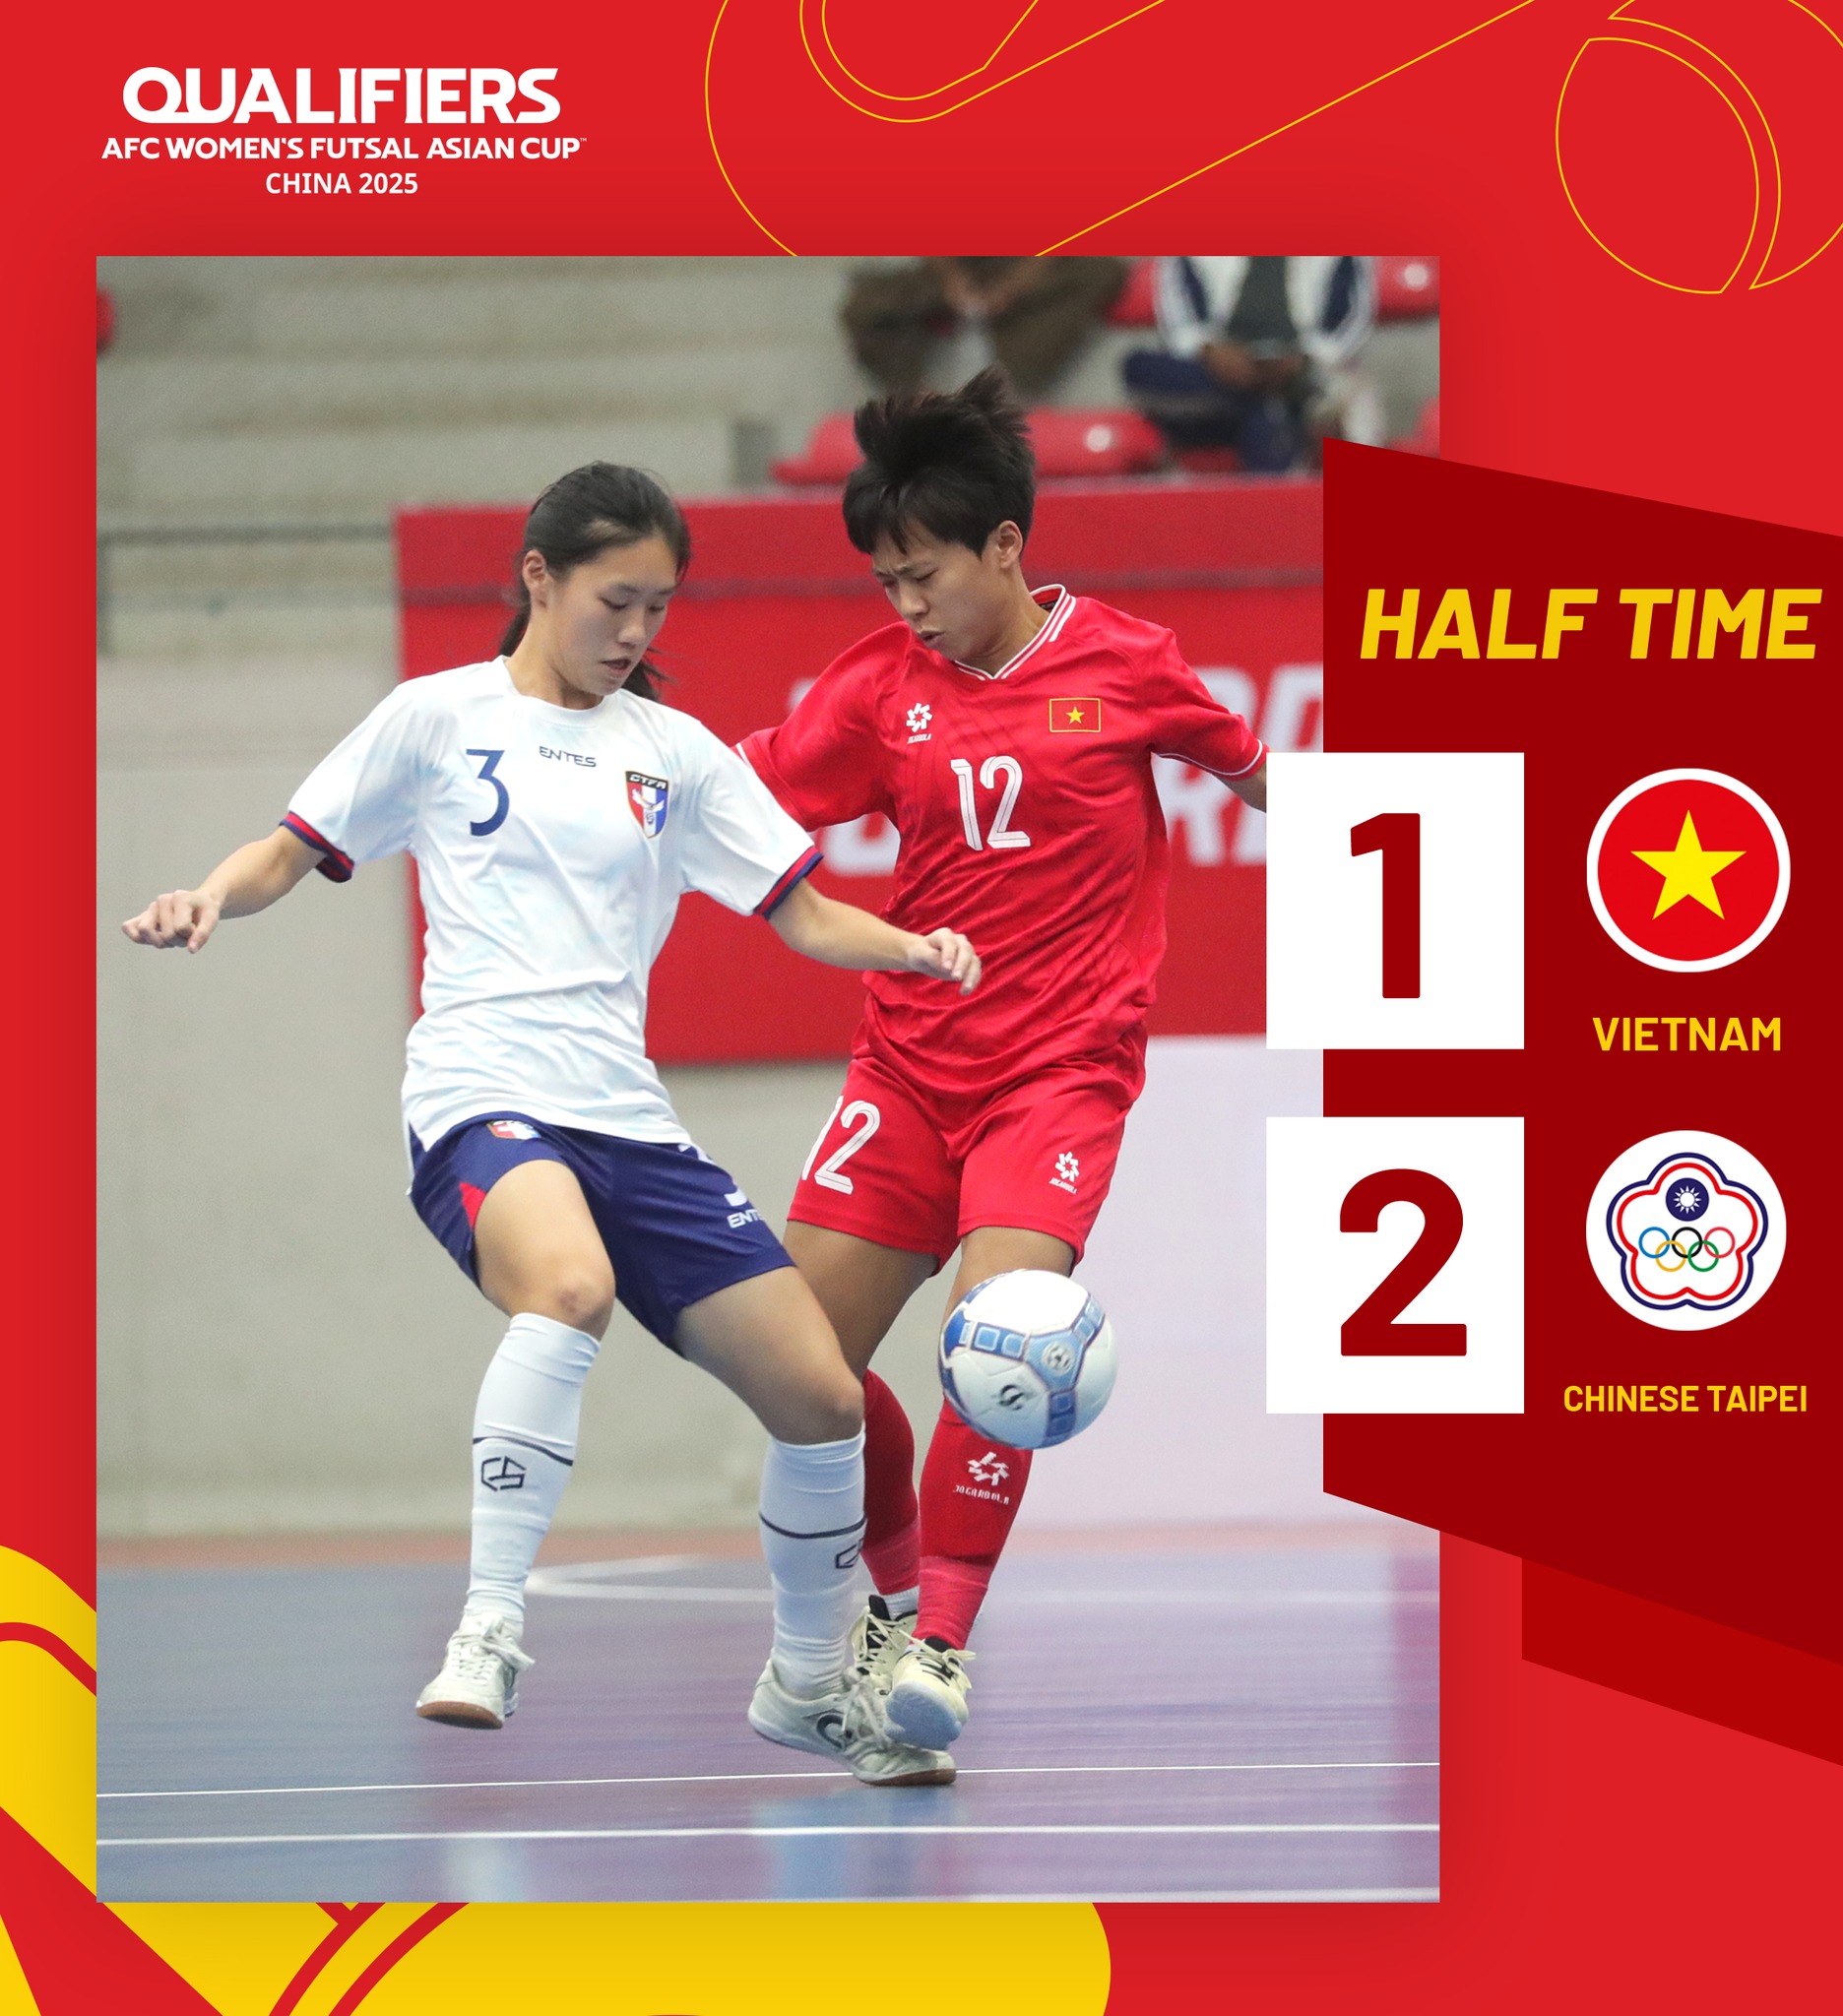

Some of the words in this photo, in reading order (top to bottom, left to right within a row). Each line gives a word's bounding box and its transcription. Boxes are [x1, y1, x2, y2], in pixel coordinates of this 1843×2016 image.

[465, 748, 510, 837] 3
[539, 745, 597, 768] ENTES
[950, 755, 1032, 851] 12
[800, 1096, 882, 1195] 12
